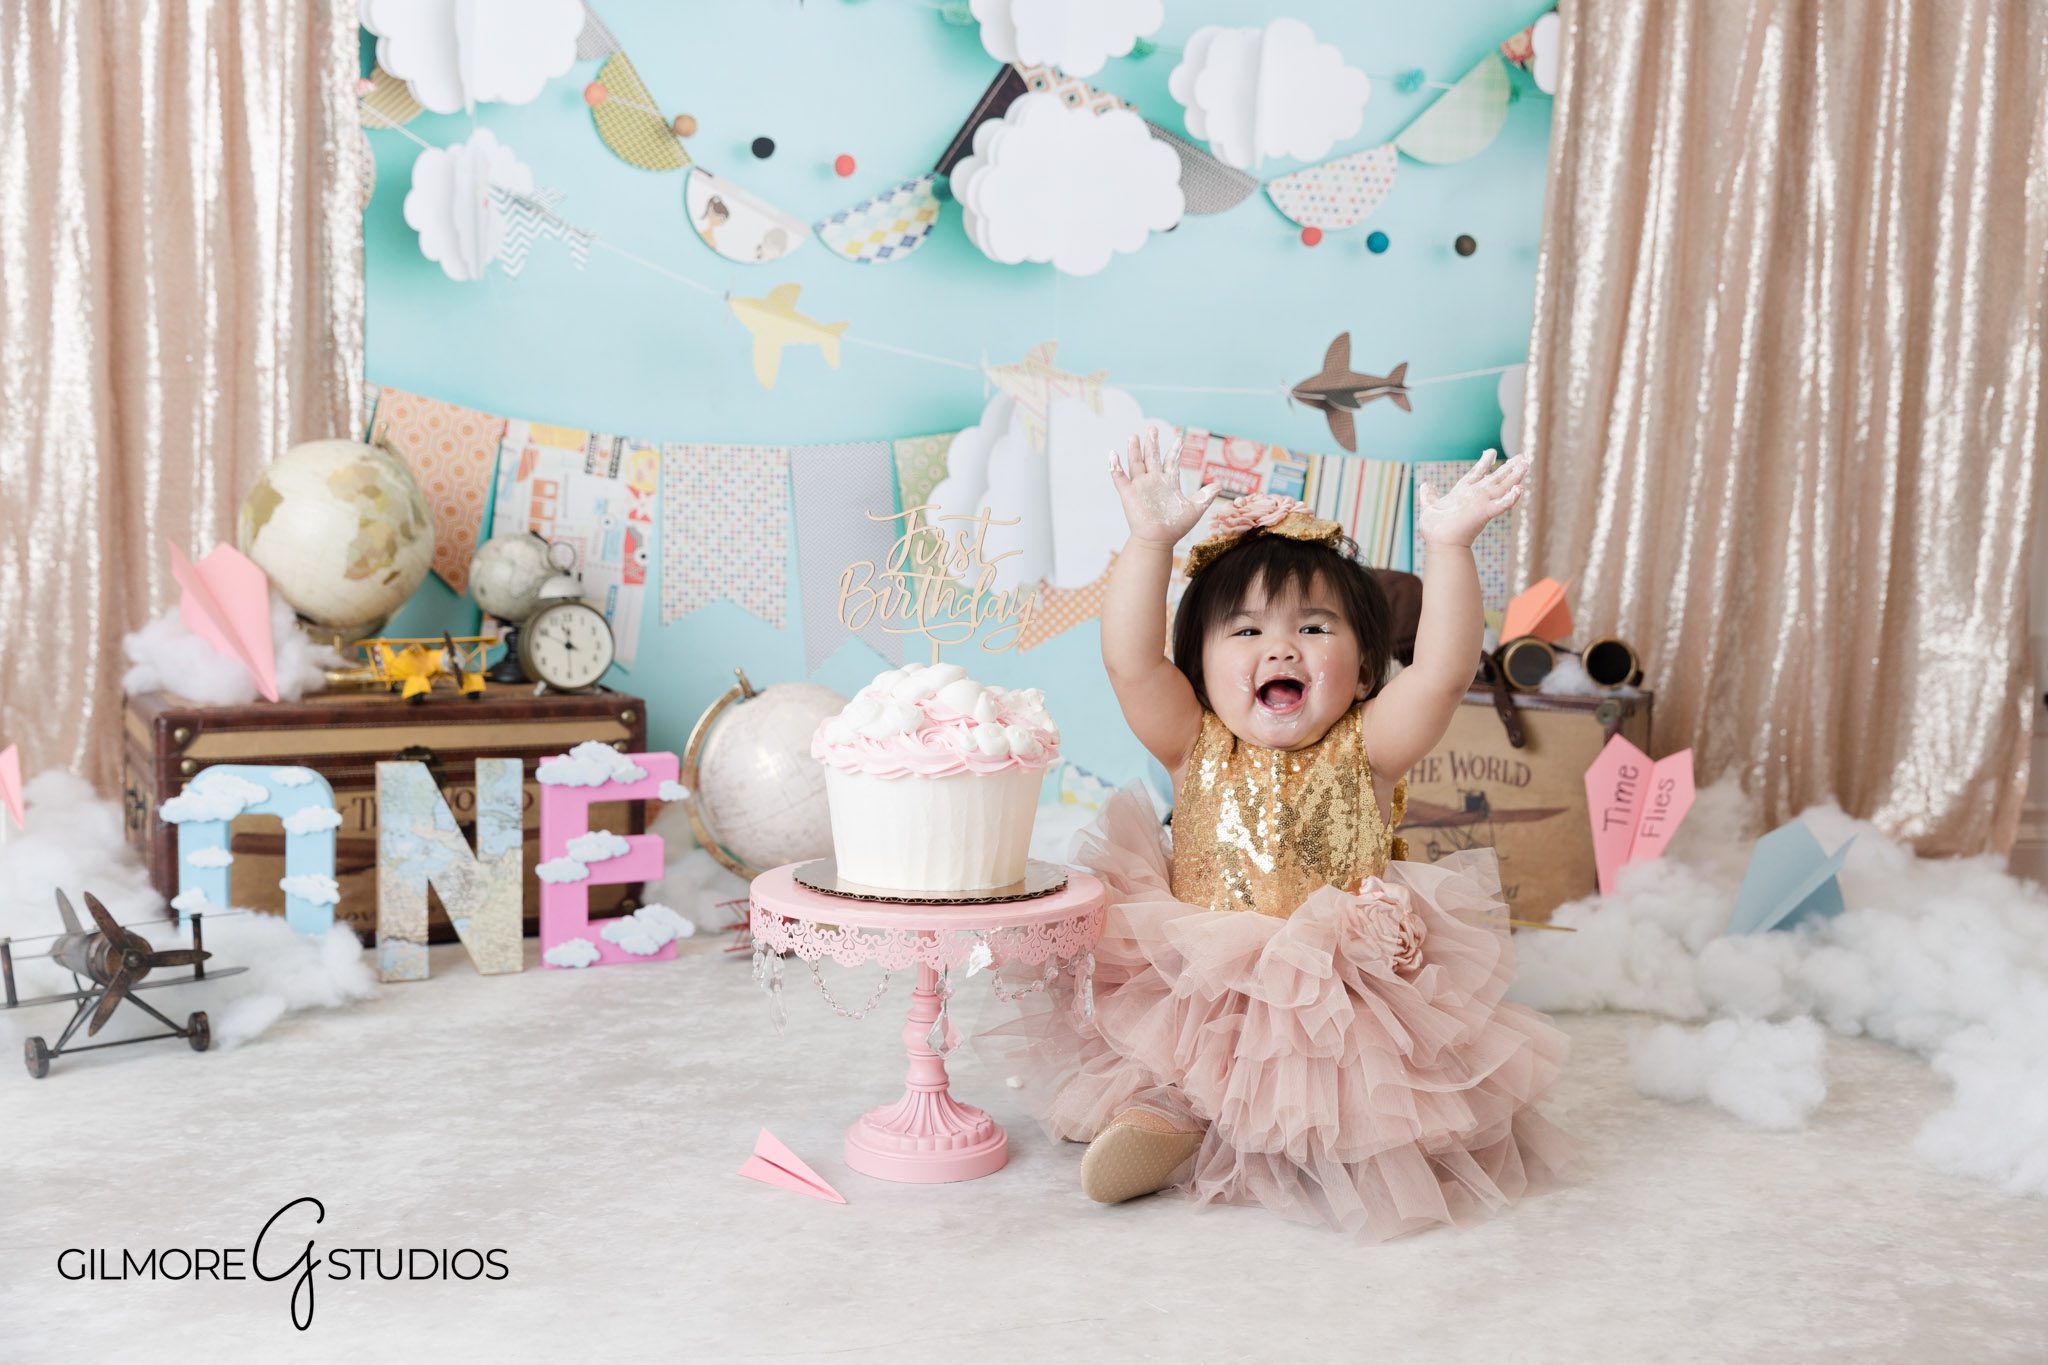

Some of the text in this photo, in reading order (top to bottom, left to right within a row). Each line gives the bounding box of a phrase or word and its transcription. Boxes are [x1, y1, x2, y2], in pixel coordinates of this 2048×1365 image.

[865, 503, 1024, 573] First
[837, 560, 1038, 654] Birthday
[1409, 750, 1532, 788] HE WORLD
[1602, 764, 1640, 833] Time
[1640, 778, 1675, 838] Flies
[176, 750, 681, 982] ONE
